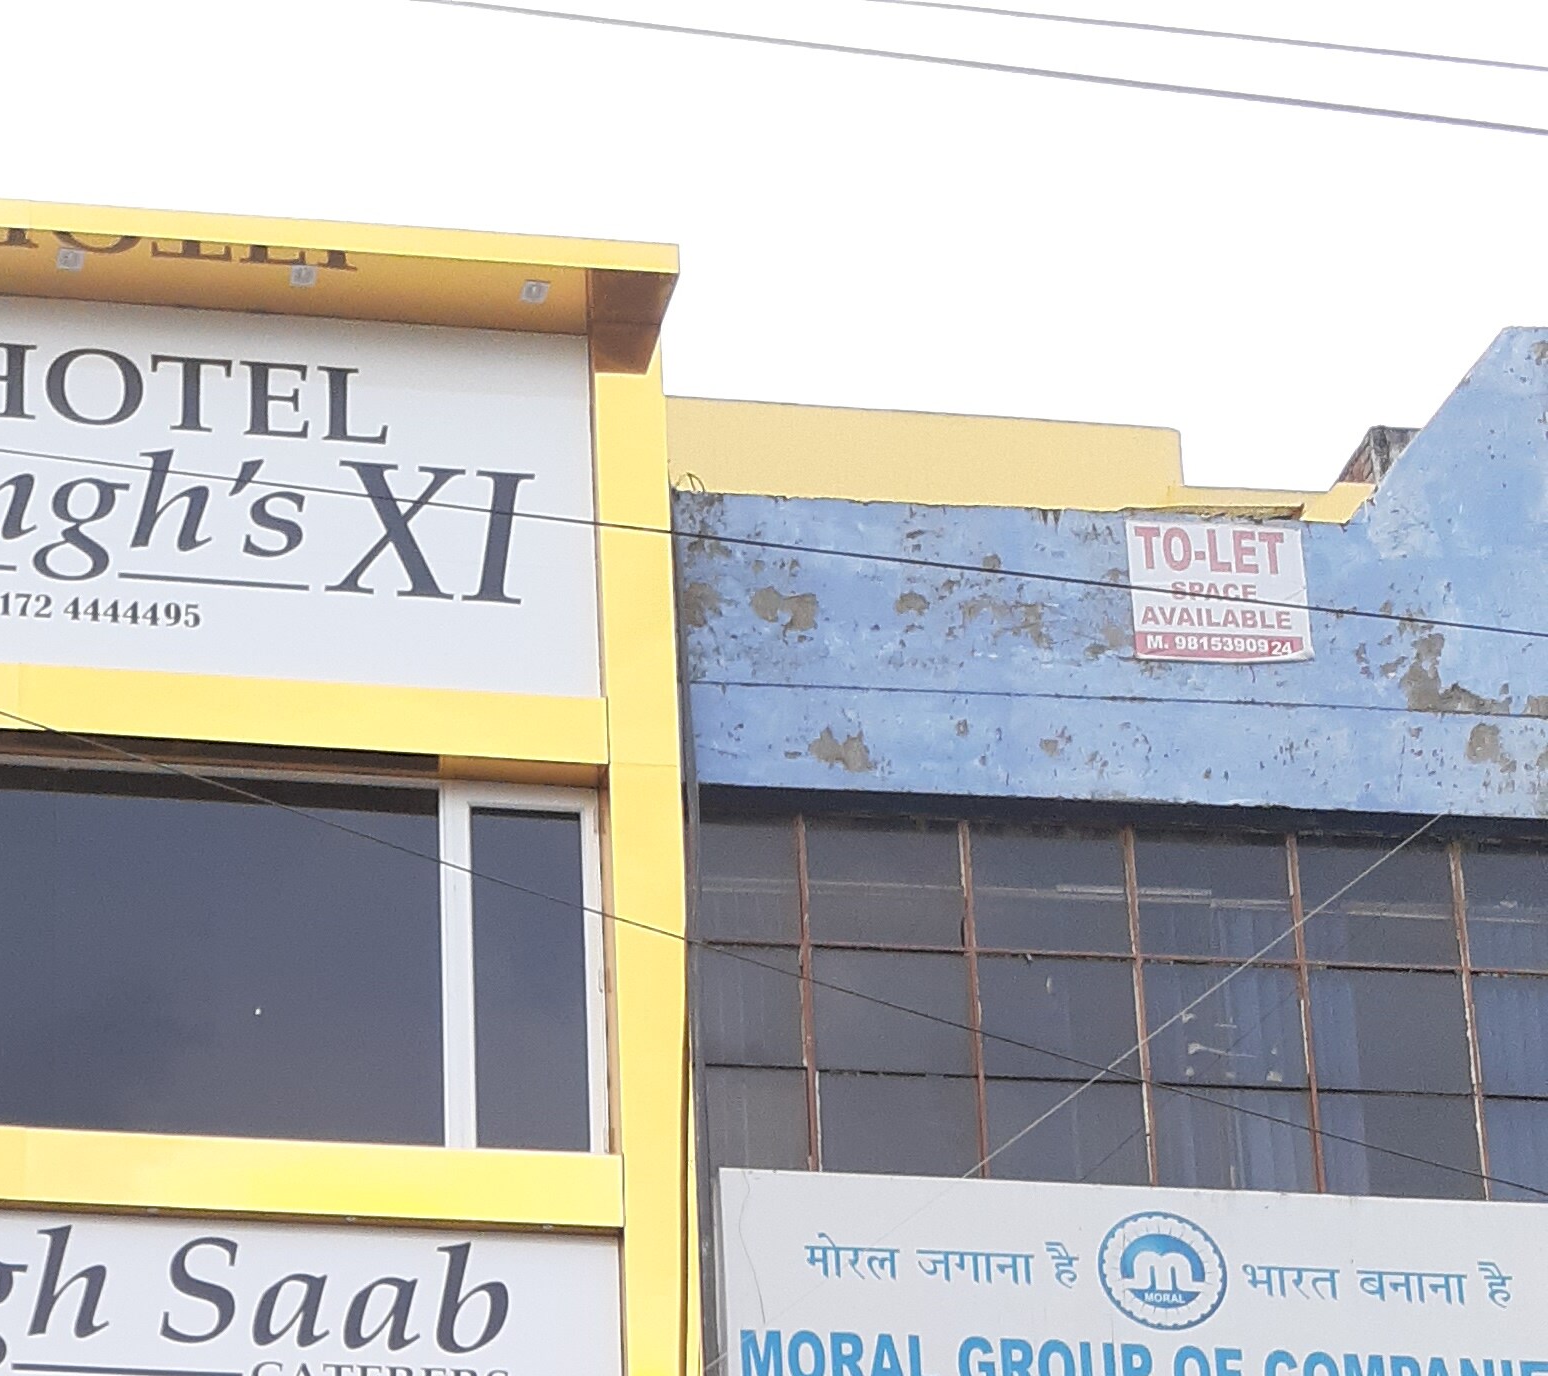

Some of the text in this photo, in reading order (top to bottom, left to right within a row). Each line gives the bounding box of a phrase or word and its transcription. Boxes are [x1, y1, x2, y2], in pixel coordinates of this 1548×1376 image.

[325, 460, 535, 606] XI
[1134, 525, 1284, 575] TO-LET
[1171, 581, 1257, 601] SPACE
[63, 597, 201, 628] 4444495
[1142, 606, 1292, 630] AVAILABLE
[1146, 635, 1169, 651] M.
[804, 1232, 1079, 1288] मोरल जगाना है
[159, 1234, 510, 1354] Saab
[1144, 1292, 1186, 1304] MORAL
[1242, 1261, 1513, 1309] भारत बनाना है
